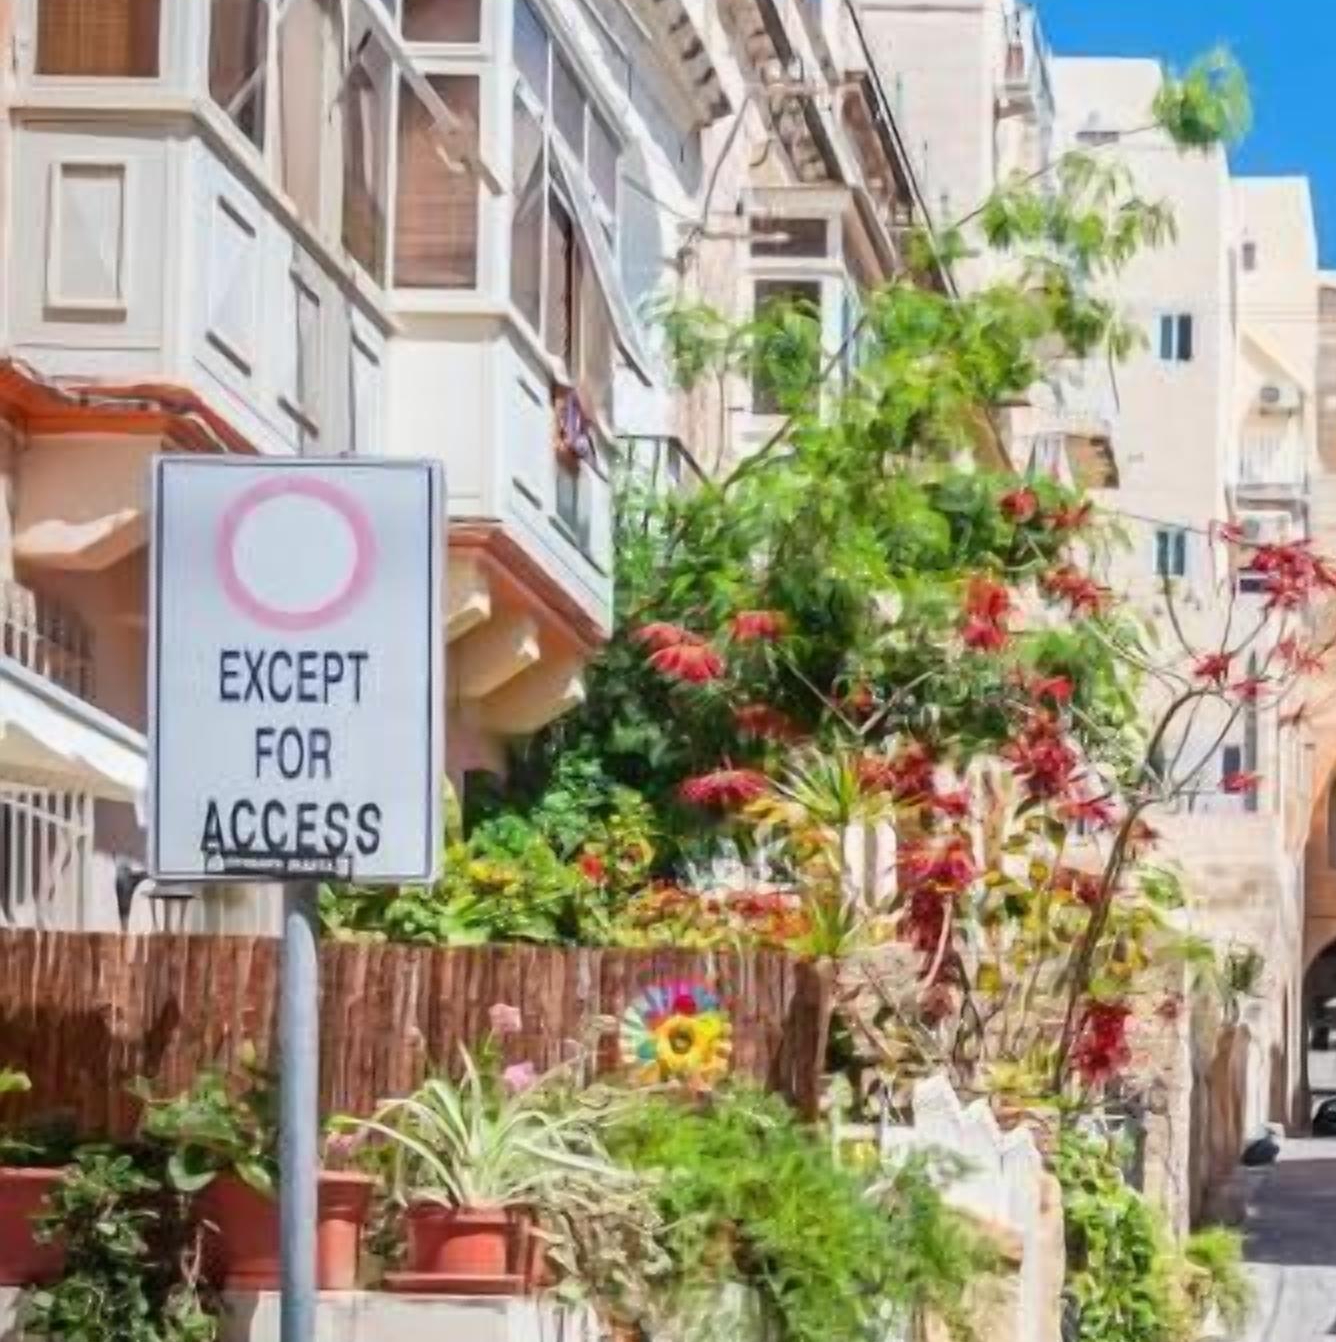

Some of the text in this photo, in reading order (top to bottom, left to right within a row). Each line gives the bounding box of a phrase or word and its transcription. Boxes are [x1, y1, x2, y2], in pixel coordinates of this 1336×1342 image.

[218, 650, 369, 703] EXCEPT
[255, 726, 333, 779] FOR
[201, 798, 382, 855] ACCESS
